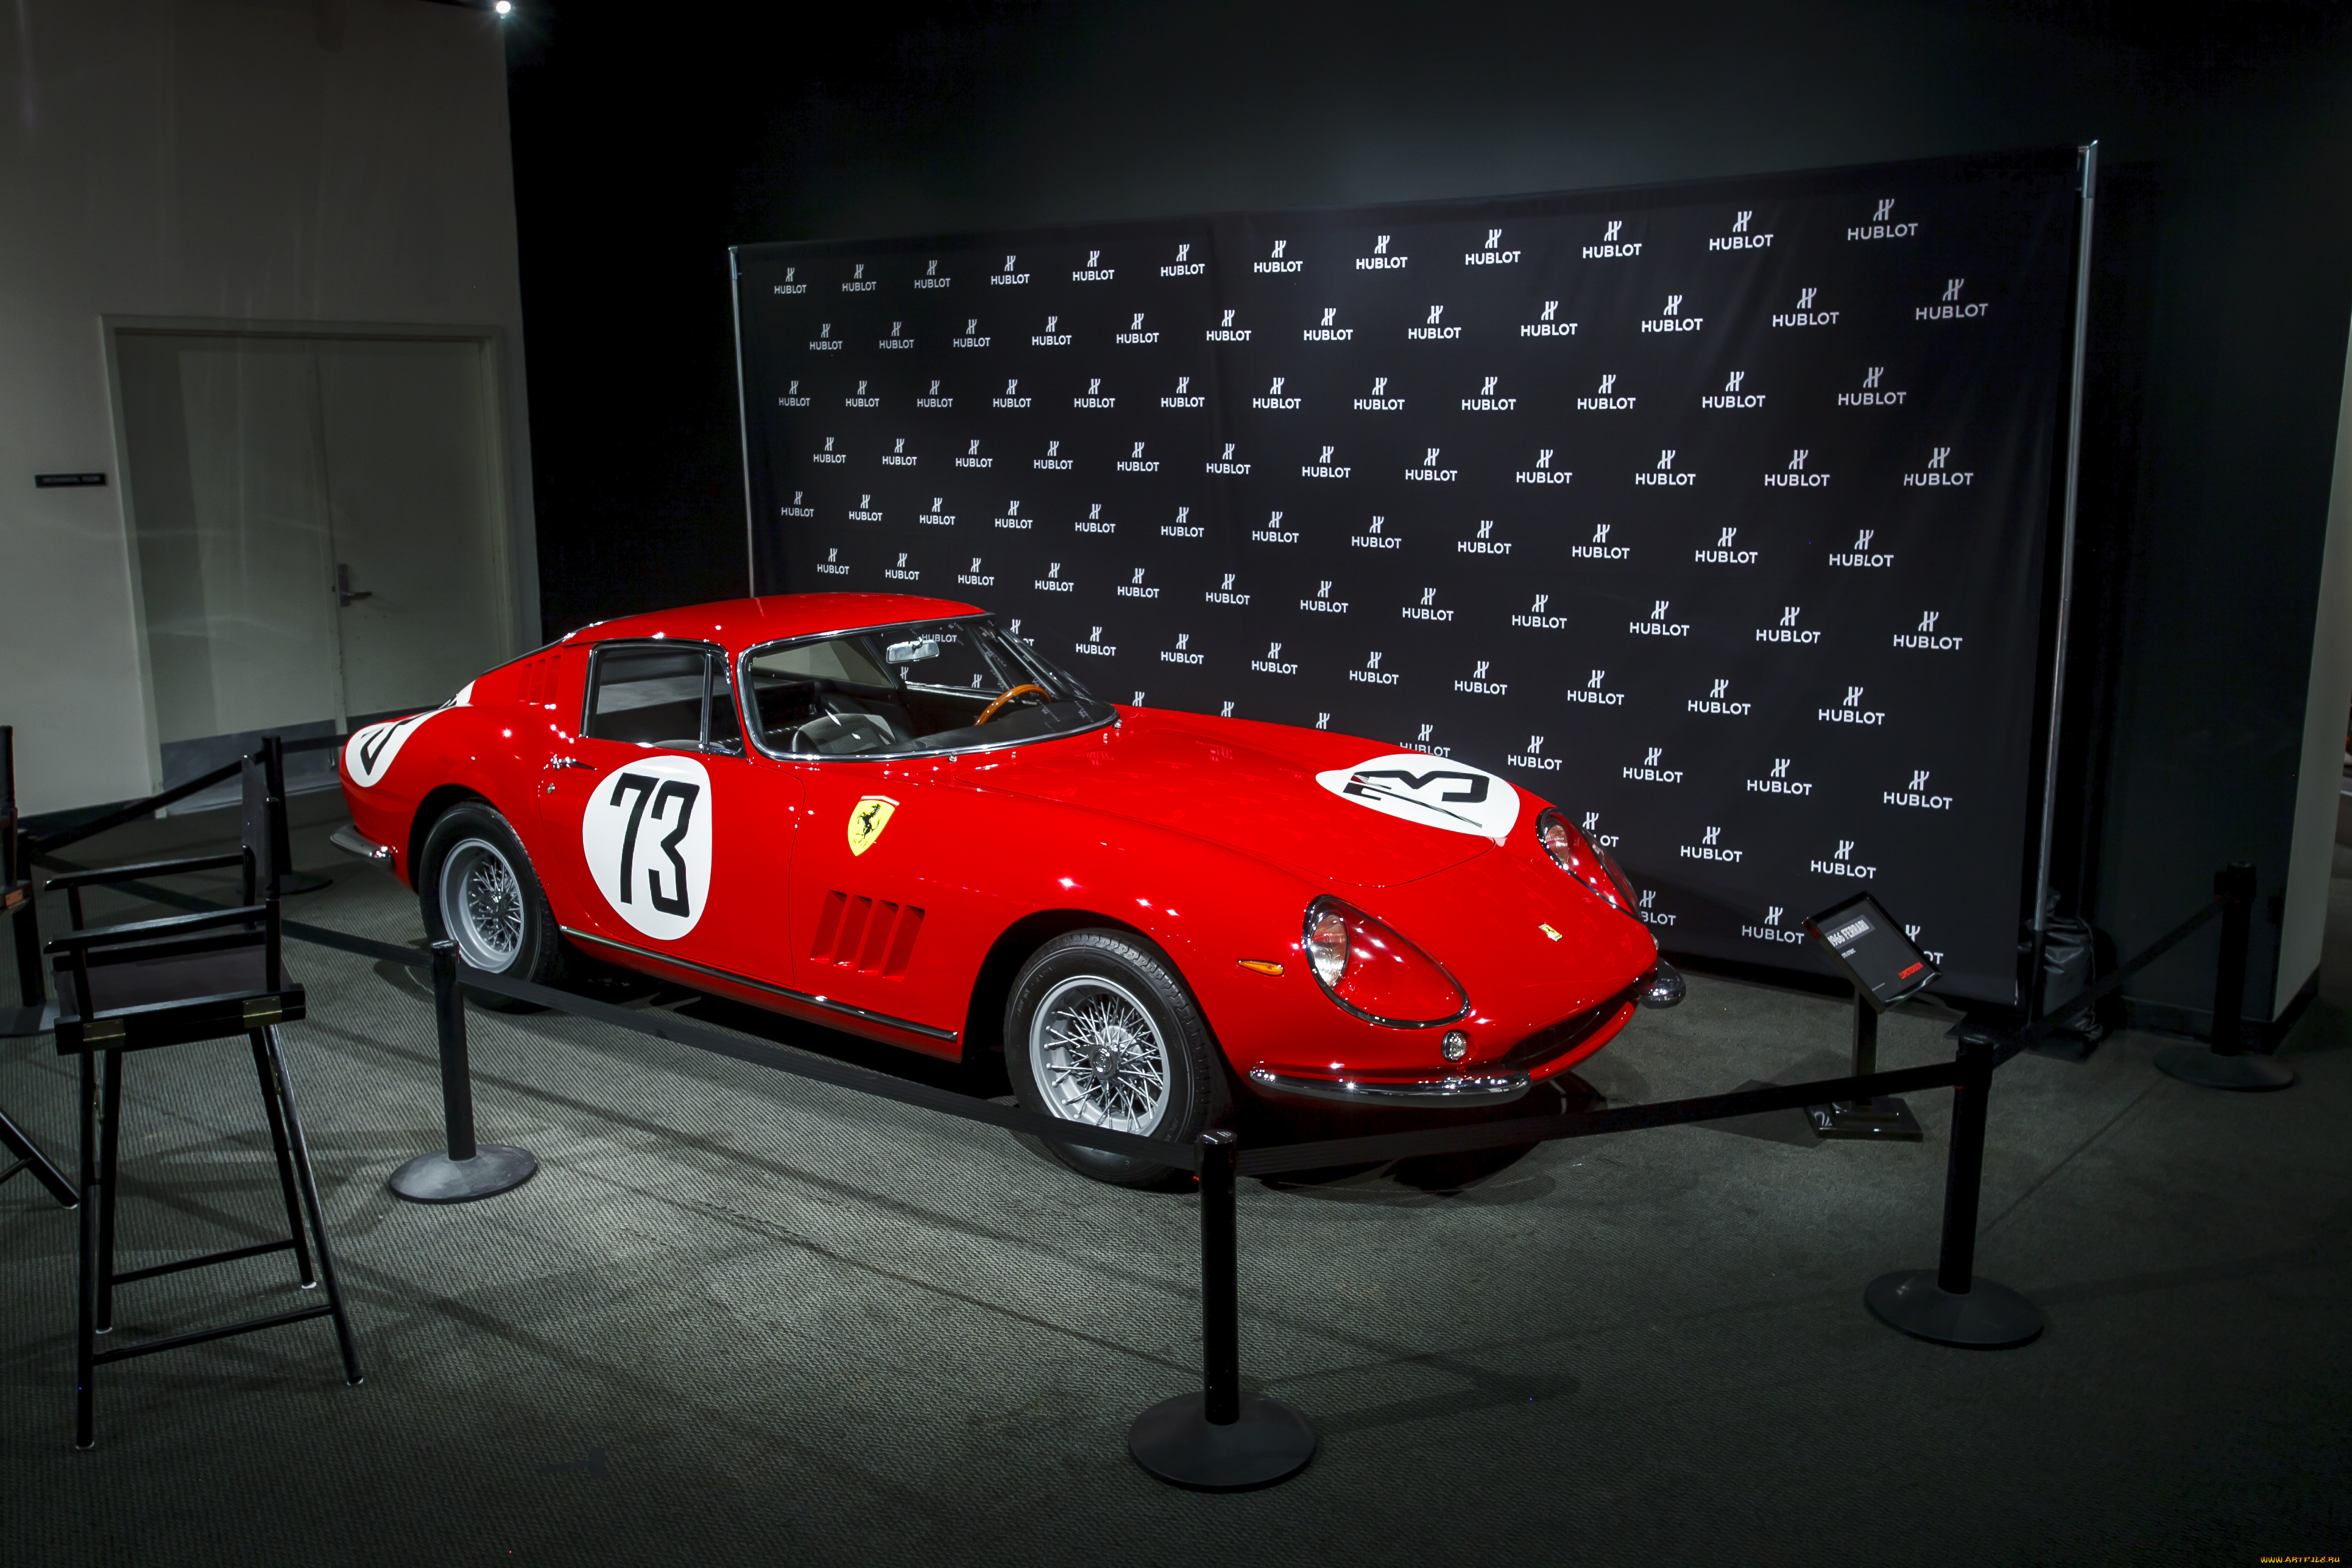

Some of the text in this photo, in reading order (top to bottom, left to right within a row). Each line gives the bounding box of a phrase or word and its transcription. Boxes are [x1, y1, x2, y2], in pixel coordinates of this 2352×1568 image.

[1848, 223, 1918, 240] HUBLOT
[1710, 235, 1773, 250] HUBLOT
[1583, 244, 1642, 258] HUBLOT
[1356, 257, 1408, 269] HUBLOT
[1466, 251, 1520, 265] HUBLOT
[1161, 264, 1205, 277] HUBLOT
[1254, 261, 1303, 272] HUBLOT
[991, 274, 1029, 284] HUBLOT
[1073, 270, 1114, 281] HUBLOT
[775, 284, 807, 294] HUBLOT
[842, 281, 876, 291] HUBLOT
[914, 278, 950, 288] HUBLOT
[1916, 303, 1988, 320] HUBLOT
[1642, 319, 1703, 332] HUBLOT
[1773, 312, 1839, 327] HUBLOT
[1304, 330, 1353, 341] HUBLOT
[1408, 327, 1461, 339] HUBLOT
[1521, 323, 1577, 336] HUBLOT
[953, 337, 991, 347] HUBLOT
[1032, 335, 1072, 345] HUBLOT
[1117, 333, 1159, 343] HUBLOT
[1207, 331, 1251, 341] HUBLOT
[810, 341, 842, 350] HUBLOT
[880, 340, 914, 348] HUBLOT
[846, 398, 879, 407] HUBLOT
[917, 398, 953, 407] HUBLOT
[993, 398, 1031, 408] HUBLOT
[1075, 398, 1115, 408] HUBLOT
[1161, 397, 1204, 407] HUBLOT
[1253, 398, 1301, 409] HUBLOT
[1354, 399, 1405, 410] HUBLOT
[1462, 399, 1516, 410] HUBLOT
[1578, 398, 1636, 409] HUBLOT
[1703, 395, 1765, 408] HUBLOT
[1838, 392, 1906, 405] HUBLOT
[814, 454, 846, 463] HUBLOT
[883, 456, 917, 465] HUBLOT
[956, 458, 992, 467] HUBLOT
[1034, 460, 1073, 469] HUBLOT
[1117, 462, 1159, 471] HUBLOT
[1207, 463, 1251, 474] HUBLOT
[1302, 467, 1351, 478] HUBLOT
[1405, 470, 1457, 481] HUBLOT
[1517, 472, 1572, 483] HUBLOT
[1636, 473, 1696, 485] HUBLOT
[1765, 475, 1830, 486] HUBLOT
[1904, 473, 1973, 486] HUBLOT
[782, 507, 814, 517] HUBLOT
[849, 511, 883, 521] HUBLOT
[920, 515, 955, 525] HUBLOT
[995, 518, 1033, 529] HUBLOT
[1075, 522, 1115, 532] HUBLOT
[1161, 526, 1204, 537] HUBLOT
[1252, 531, 1299, 543] HUBLOT
[1352, 536, 1401, 548] HUBLOT
[1458, 542, 1511, 554] HUBLOT
[1572, 546, 1630, 559] HUBLOT
[1695, 550, 1757, 563] HUBLOT
[1829, 554, 1894, 567] HUBLOT
[818, 564, 849, 574] HUBLOT
[886, 570, 919, 580] HUBLOT
[958, 575, 994, 585] HUBLOT
[1035, 581, 1074, 592] HUBLOT
[1118, 586, 1159, 598] HUBLOT
[1206, 592, 1250, 604] HUBLOT
[1301, 600, 1348, 613] HUBLOT
[1403, 607, 1453, 621] HUBLOT
[1513, 615, 1567, 629] HUBLOT
[1630, 622, 1689, 636] HUBLOT
[1756, 629, 1820, 643] HUBLOT
[1894, 635, 1962, 649] HUBLOT
[1076, 643, 1116, 655] HUBLOT
[1161, 651, 1204, 664] HUBLOT
[1252, 660, 1298, 674] HUBLOT
[1350, 670, 1399, 684] HUBLOT
[1455, 680, 1507, 695] HUBLOT
[1567, 690, 1624, 705] HUBLOT
[1688, 700, 1751, 715] HUBLOT
[1819, 709, 1885, 725] HUBLOT
[1508, 755, 1562, 771] HUBLOT
[1623, 767, 1683, 783] HUBLOT
[1748, 780, 1812, 795] HUBLOT
[1884, 792, 1952, 810] HUBLOT
[610, 772, 700, 917] 73
[1681, 846, 1742, 862] HUBLOT
[1811, 860, 1876, 878] HUBLOT
[1641, 911, 1676, 925] BLOT
[1742, 925, 1804, 944] HUBLOT
[1827, 931, 1846, 947] 1966
